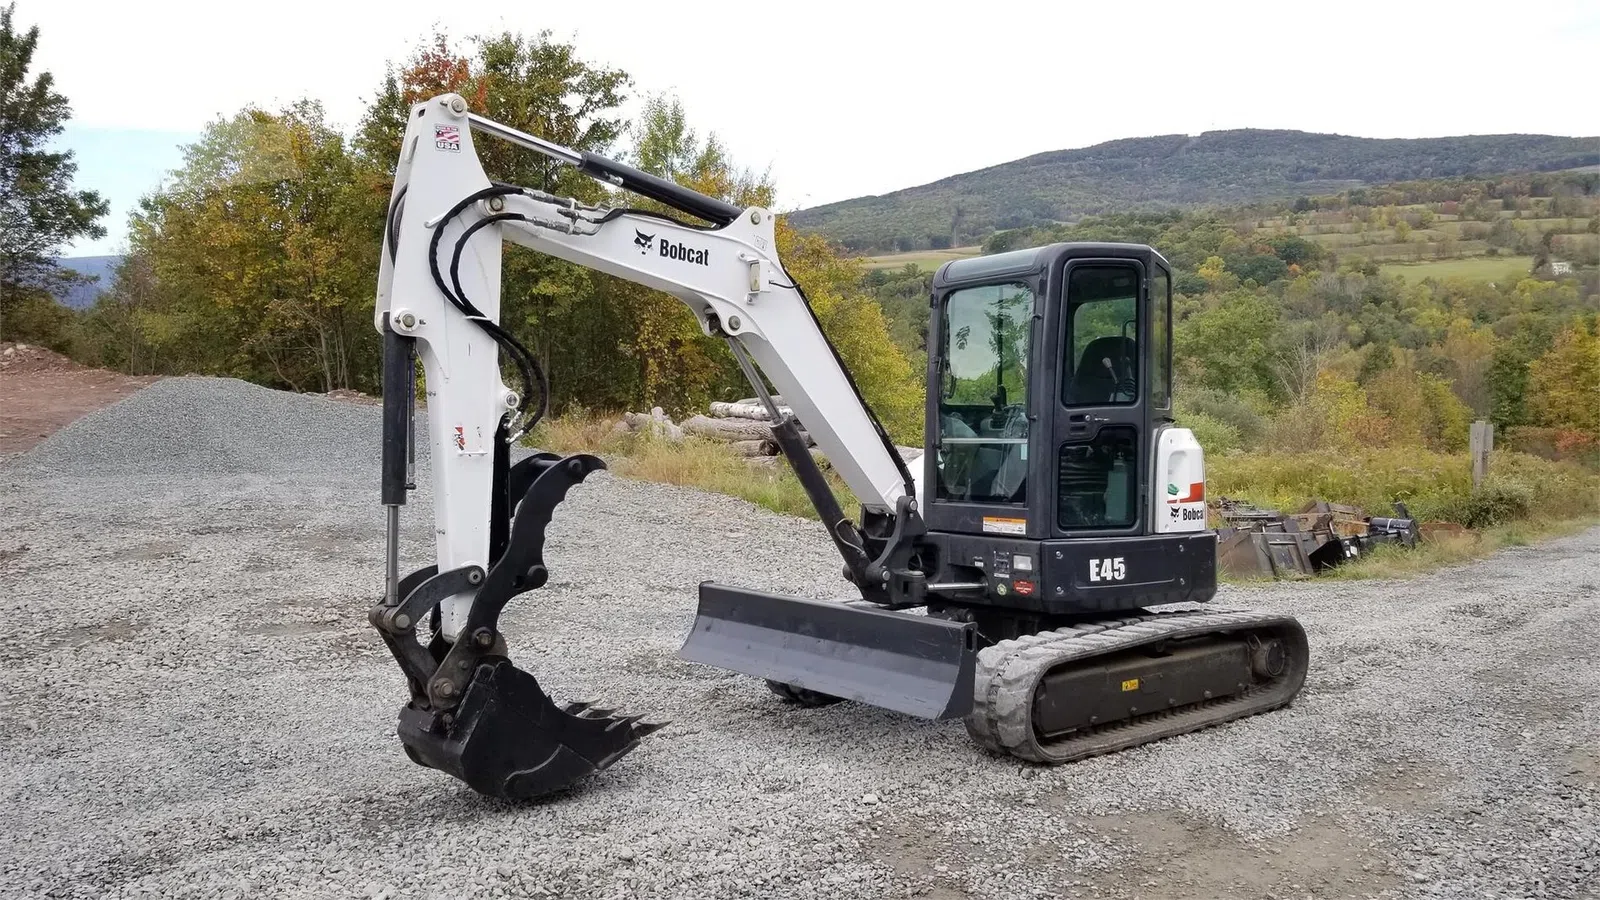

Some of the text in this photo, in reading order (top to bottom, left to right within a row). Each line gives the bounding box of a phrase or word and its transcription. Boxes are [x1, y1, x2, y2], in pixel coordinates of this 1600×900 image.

[436, 141, 459, 150] USA
[660, 239, 709, 266] Bobcat
[1182, 508, 1204, 520] Bobca
[1090, 557, 1125, 581] E45
